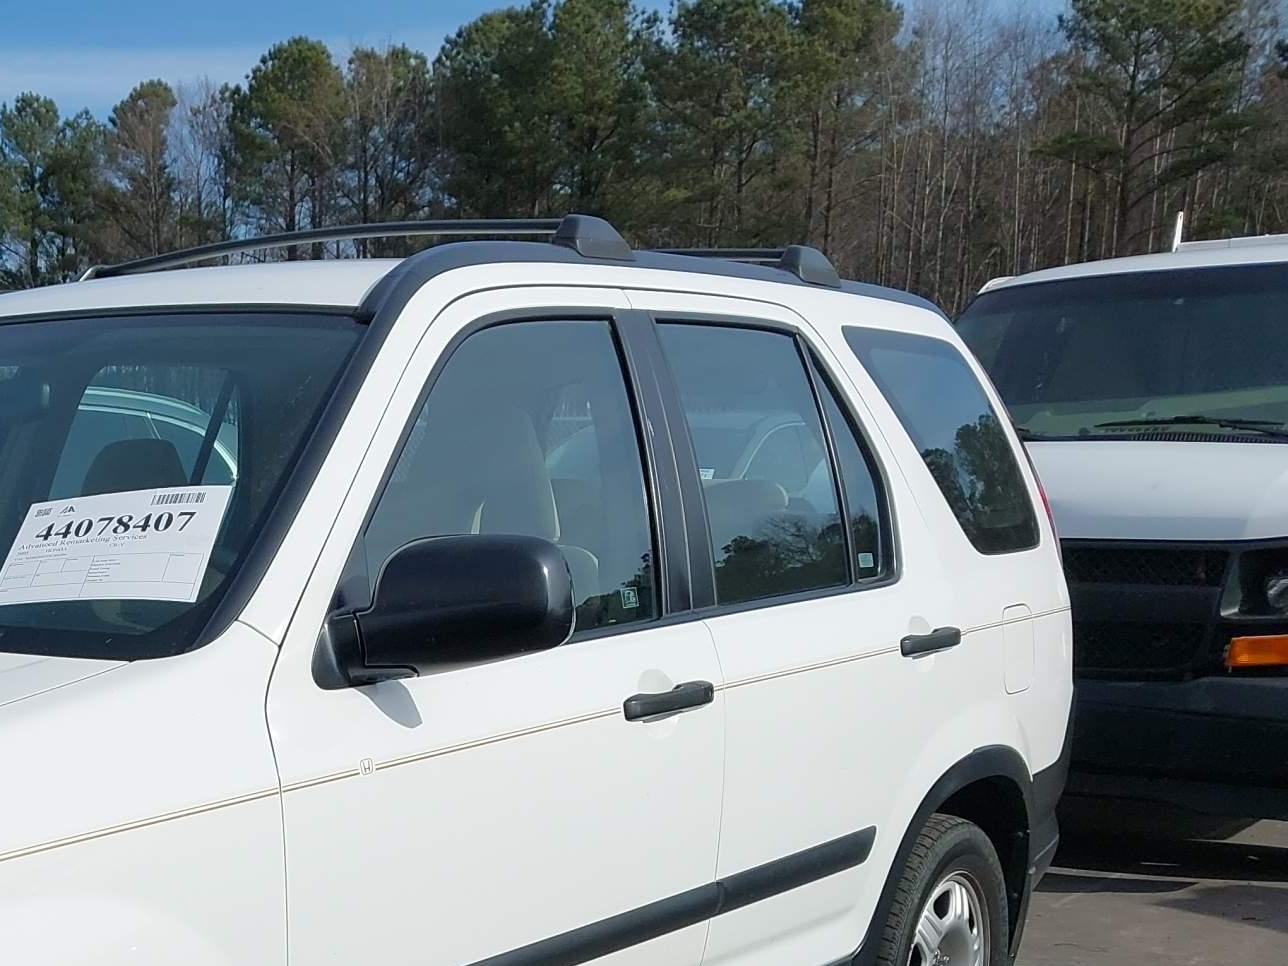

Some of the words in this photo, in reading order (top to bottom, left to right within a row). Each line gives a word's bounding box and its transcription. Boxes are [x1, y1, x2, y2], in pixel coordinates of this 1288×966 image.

[34, 511, 197, 541] 44078407
[18, 539, 59, 551] Advanced
[59, 536, 111, 548] Remarketing
[112, 533, 148, 542] Services
